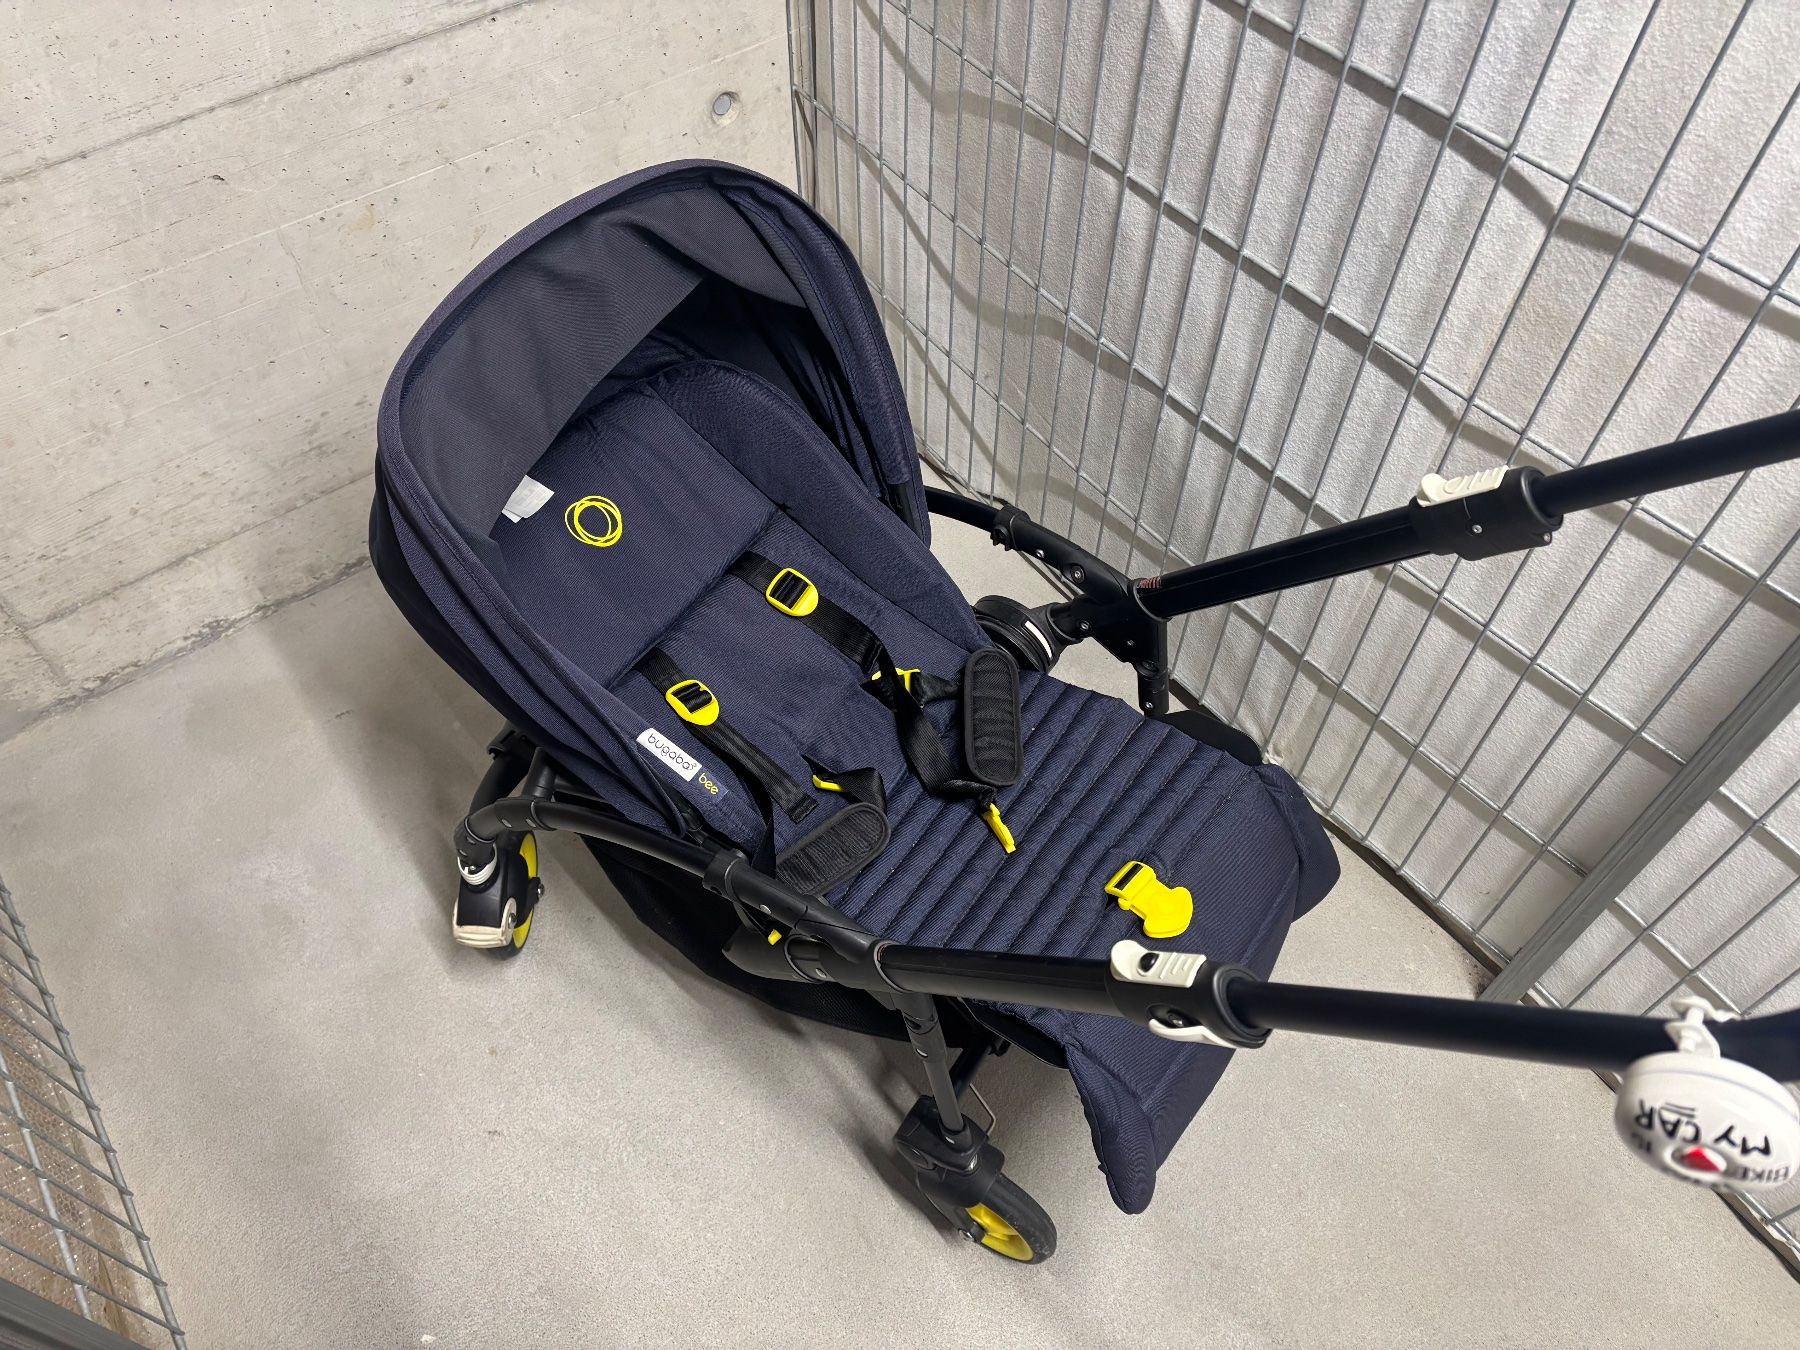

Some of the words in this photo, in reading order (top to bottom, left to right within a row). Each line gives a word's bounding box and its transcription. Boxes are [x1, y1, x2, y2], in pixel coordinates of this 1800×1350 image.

[698, 772, 719, 795] bee
[1634, 1099, 1701, 1143] CAR
[1713, 1125, 1771, 1156] MY
